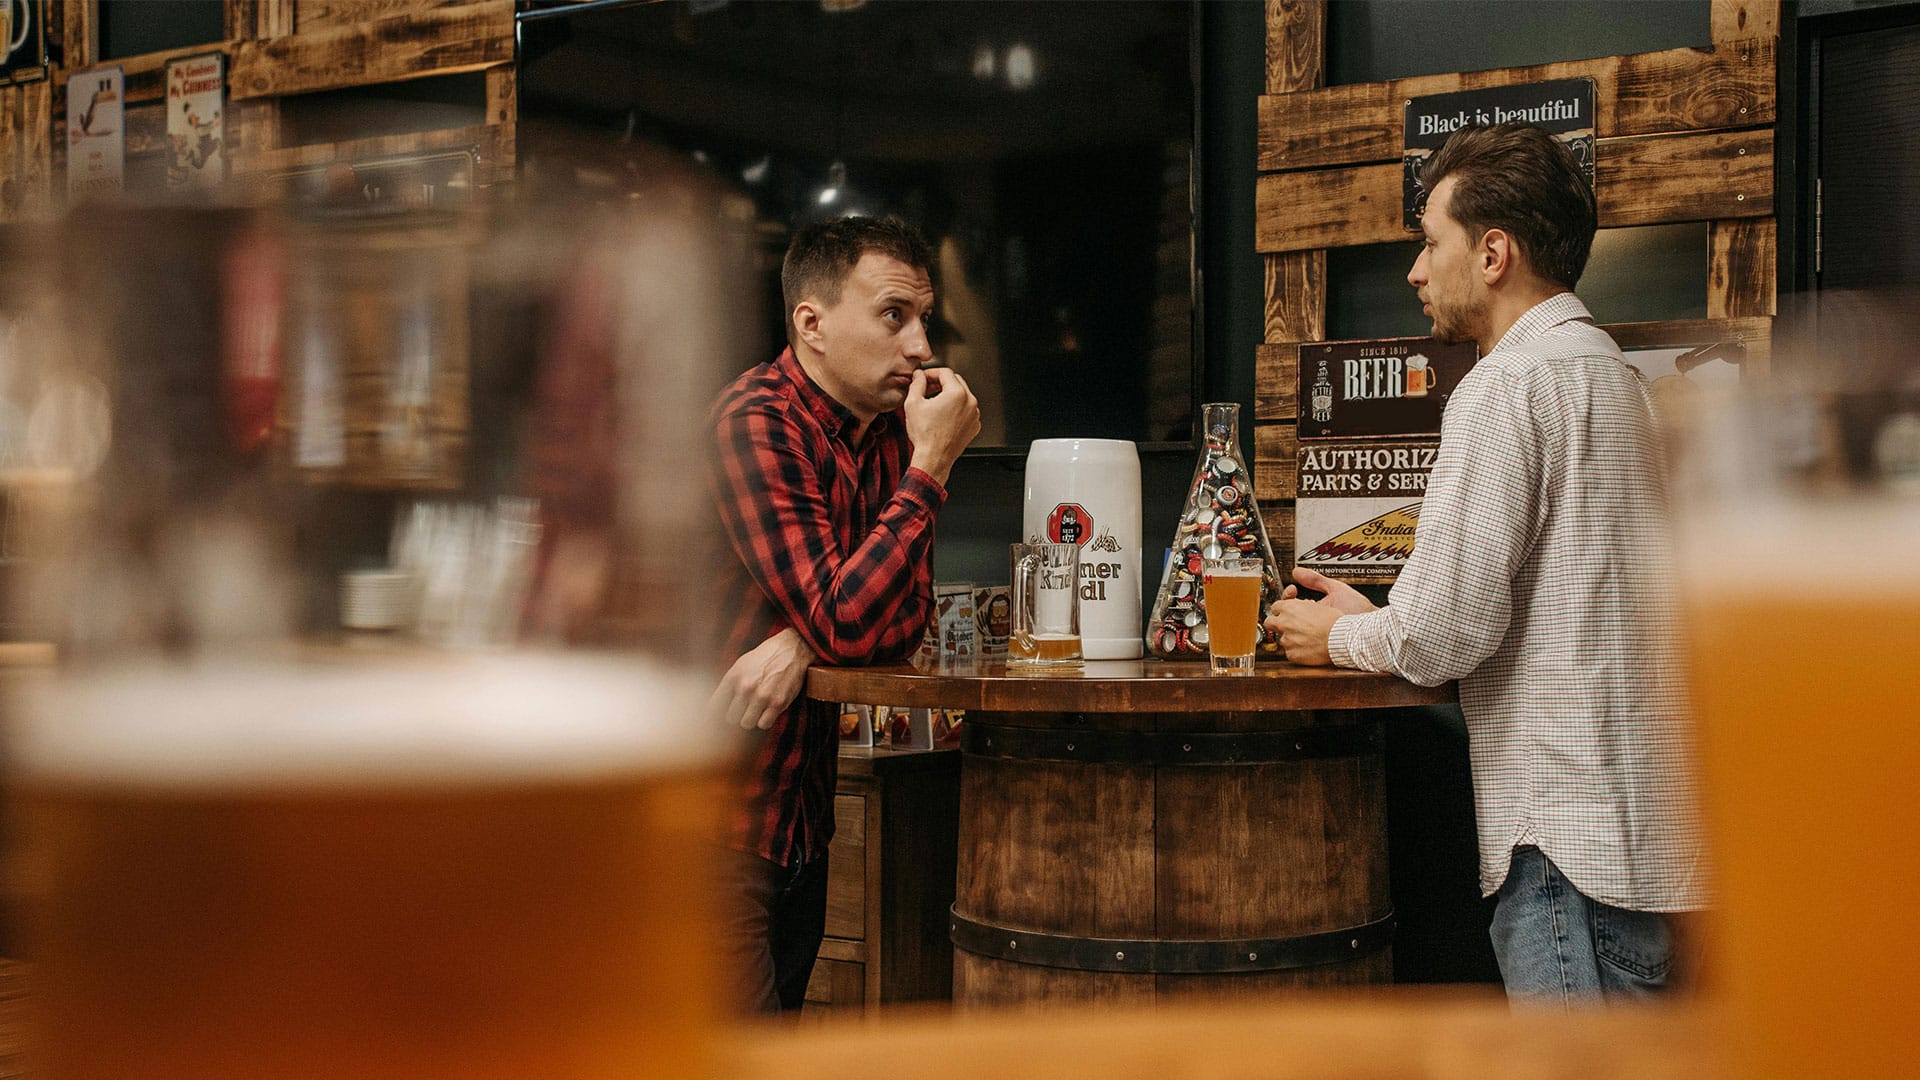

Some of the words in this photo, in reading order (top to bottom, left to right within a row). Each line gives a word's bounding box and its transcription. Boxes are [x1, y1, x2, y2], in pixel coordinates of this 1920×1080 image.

[1418, 111, 1470, 136] Black
[1476, 108, 1490, 126] is
[1494, 98, 1580, 125] beautiful
[1360, 347, 1386, 357] SINCE
[1390, 346, 1408, 355] 1810
[1343, 357, 1404, 401] BEER
[1302, 448, 1439, 471] AUTHORIZ
[1302, 474, 1362, 491] PARTS
[1367, 473, 1383, 490] &
[1325, 567, 1366, 575] MOTORCYCLE
[1366, 567, 1397, 575] COMPANY
